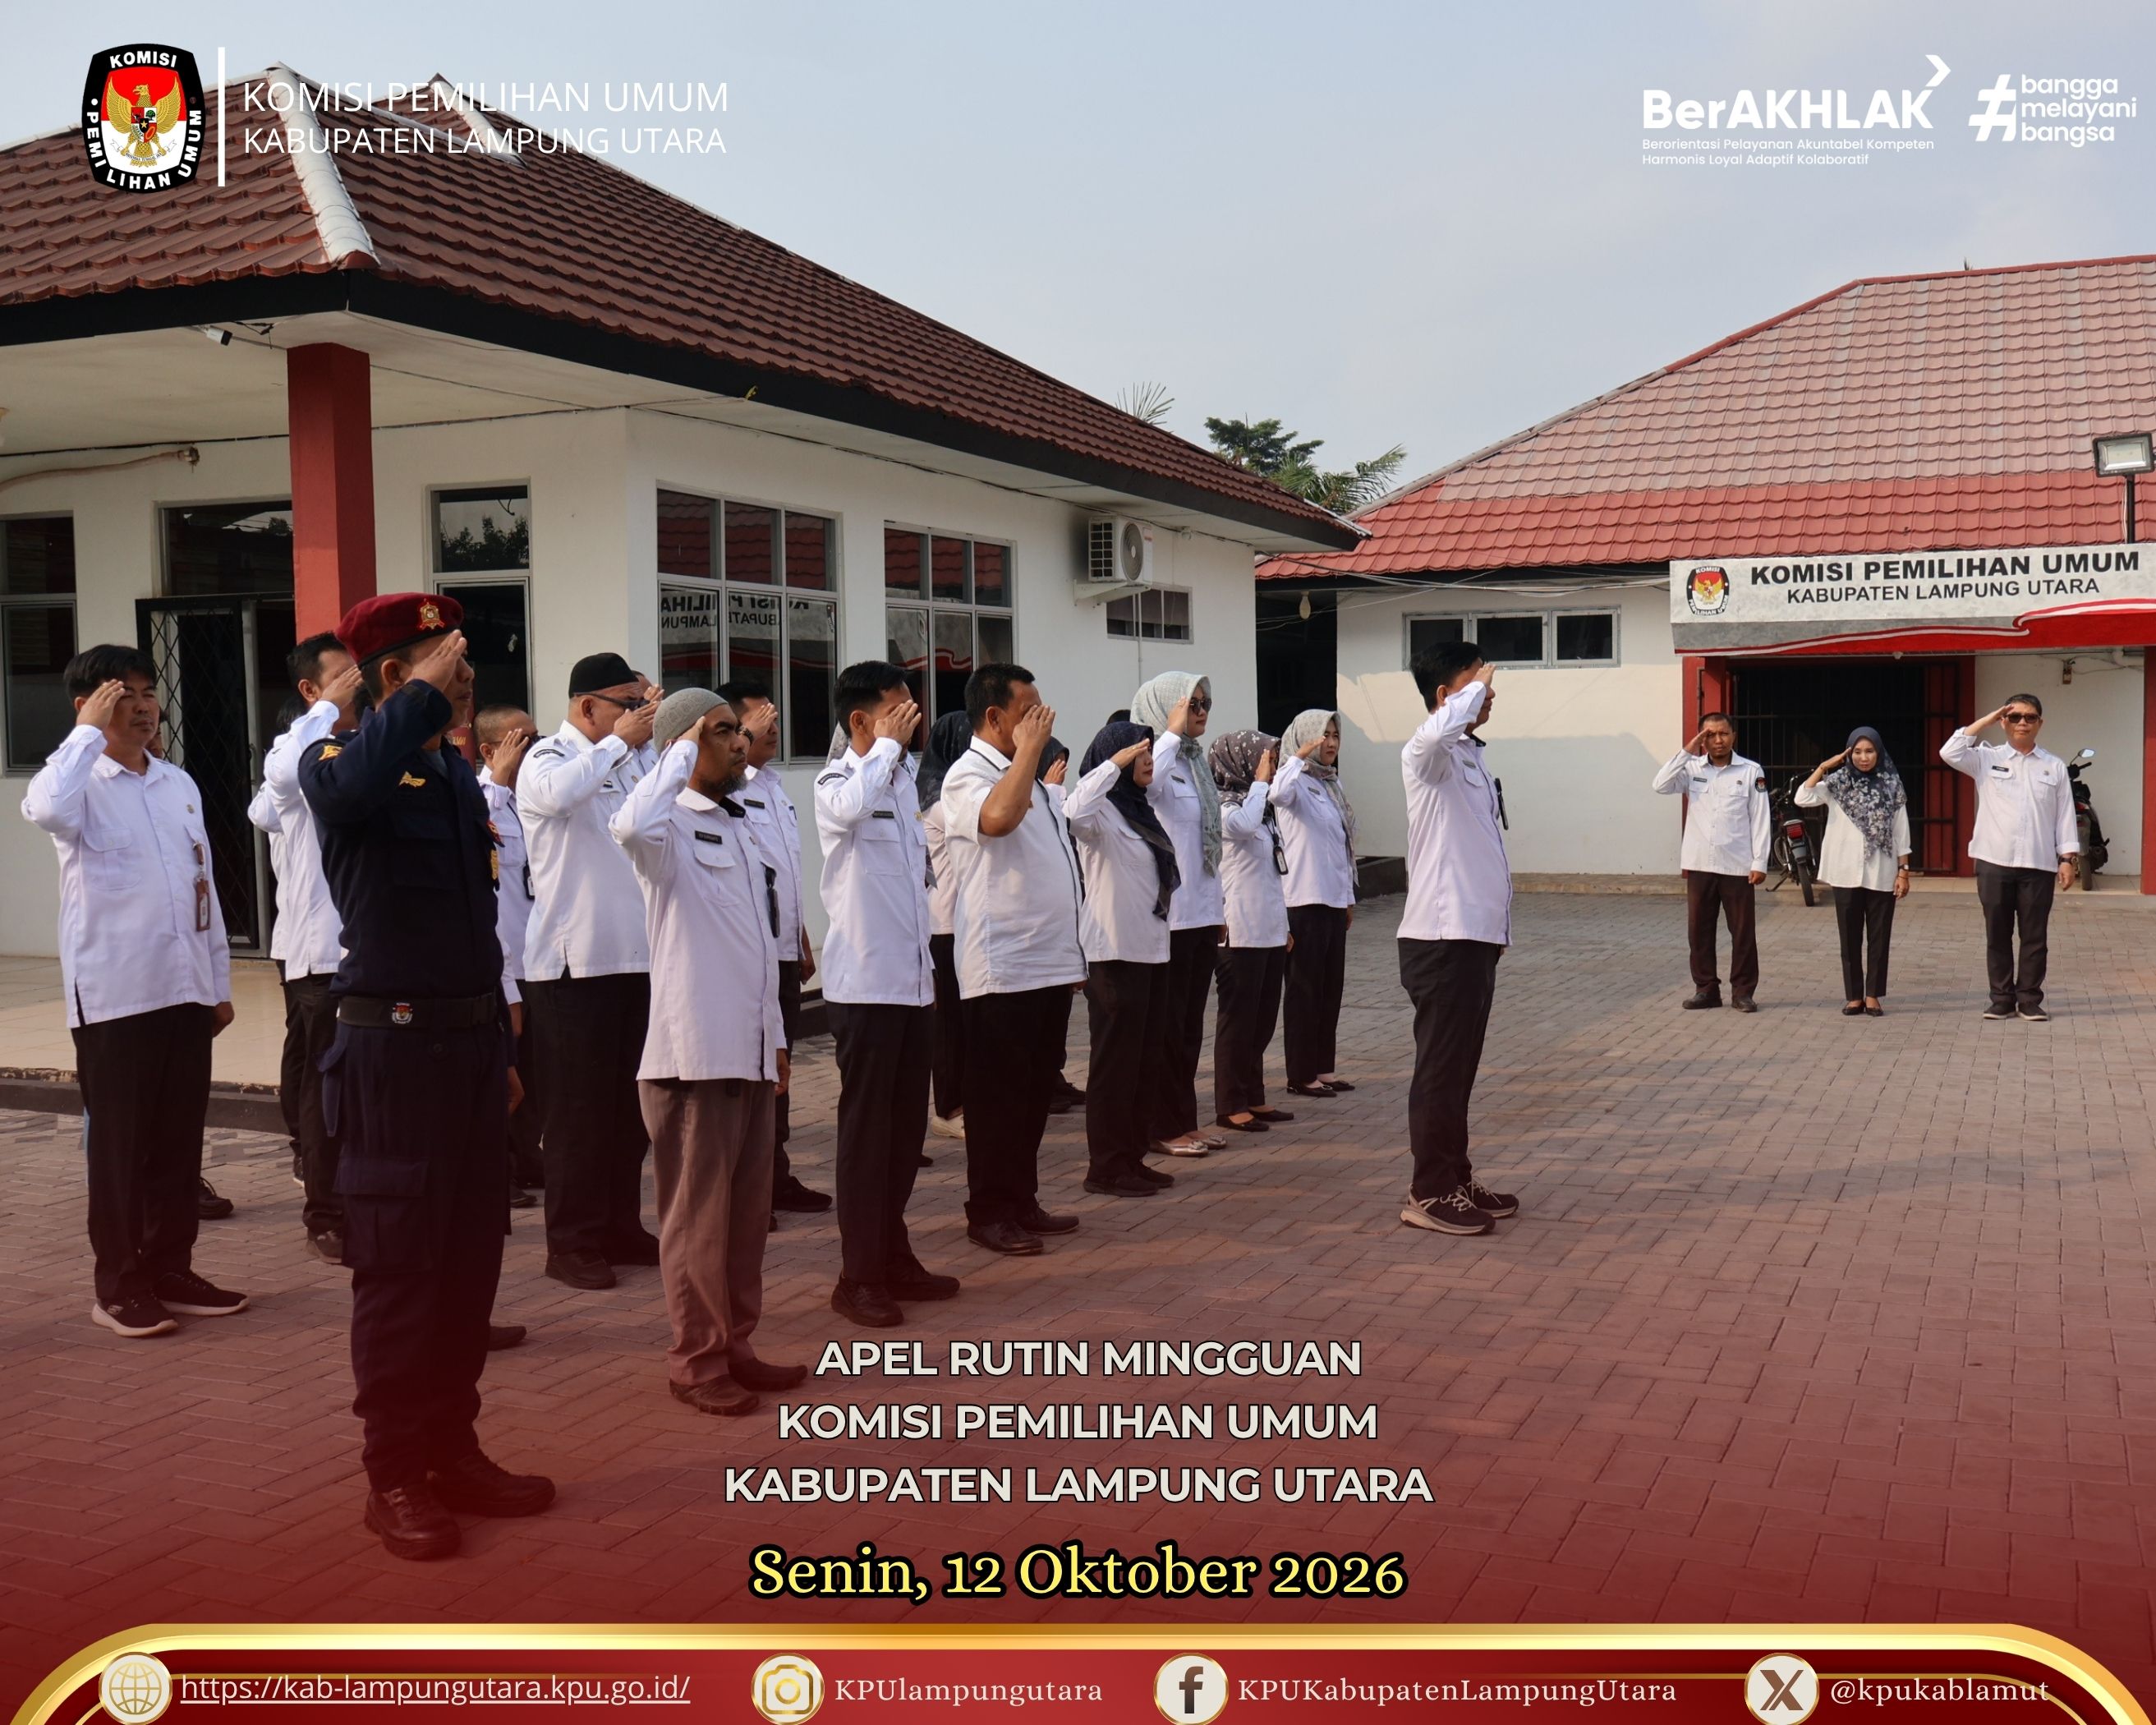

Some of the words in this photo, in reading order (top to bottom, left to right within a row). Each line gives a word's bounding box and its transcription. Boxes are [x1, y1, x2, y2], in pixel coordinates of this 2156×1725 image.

[1751, 563, 1853, 585] KOMISI
[1864, 556, 2030, 580] PEMILIHAN
[2043, 551, 2140, 573] UMUM
[1787, 586, 1909, 604] KABUPATEN
[1916, 581, 2020, 599] LAMPUNG
[2028, 578, 2100, 595] UTARA
